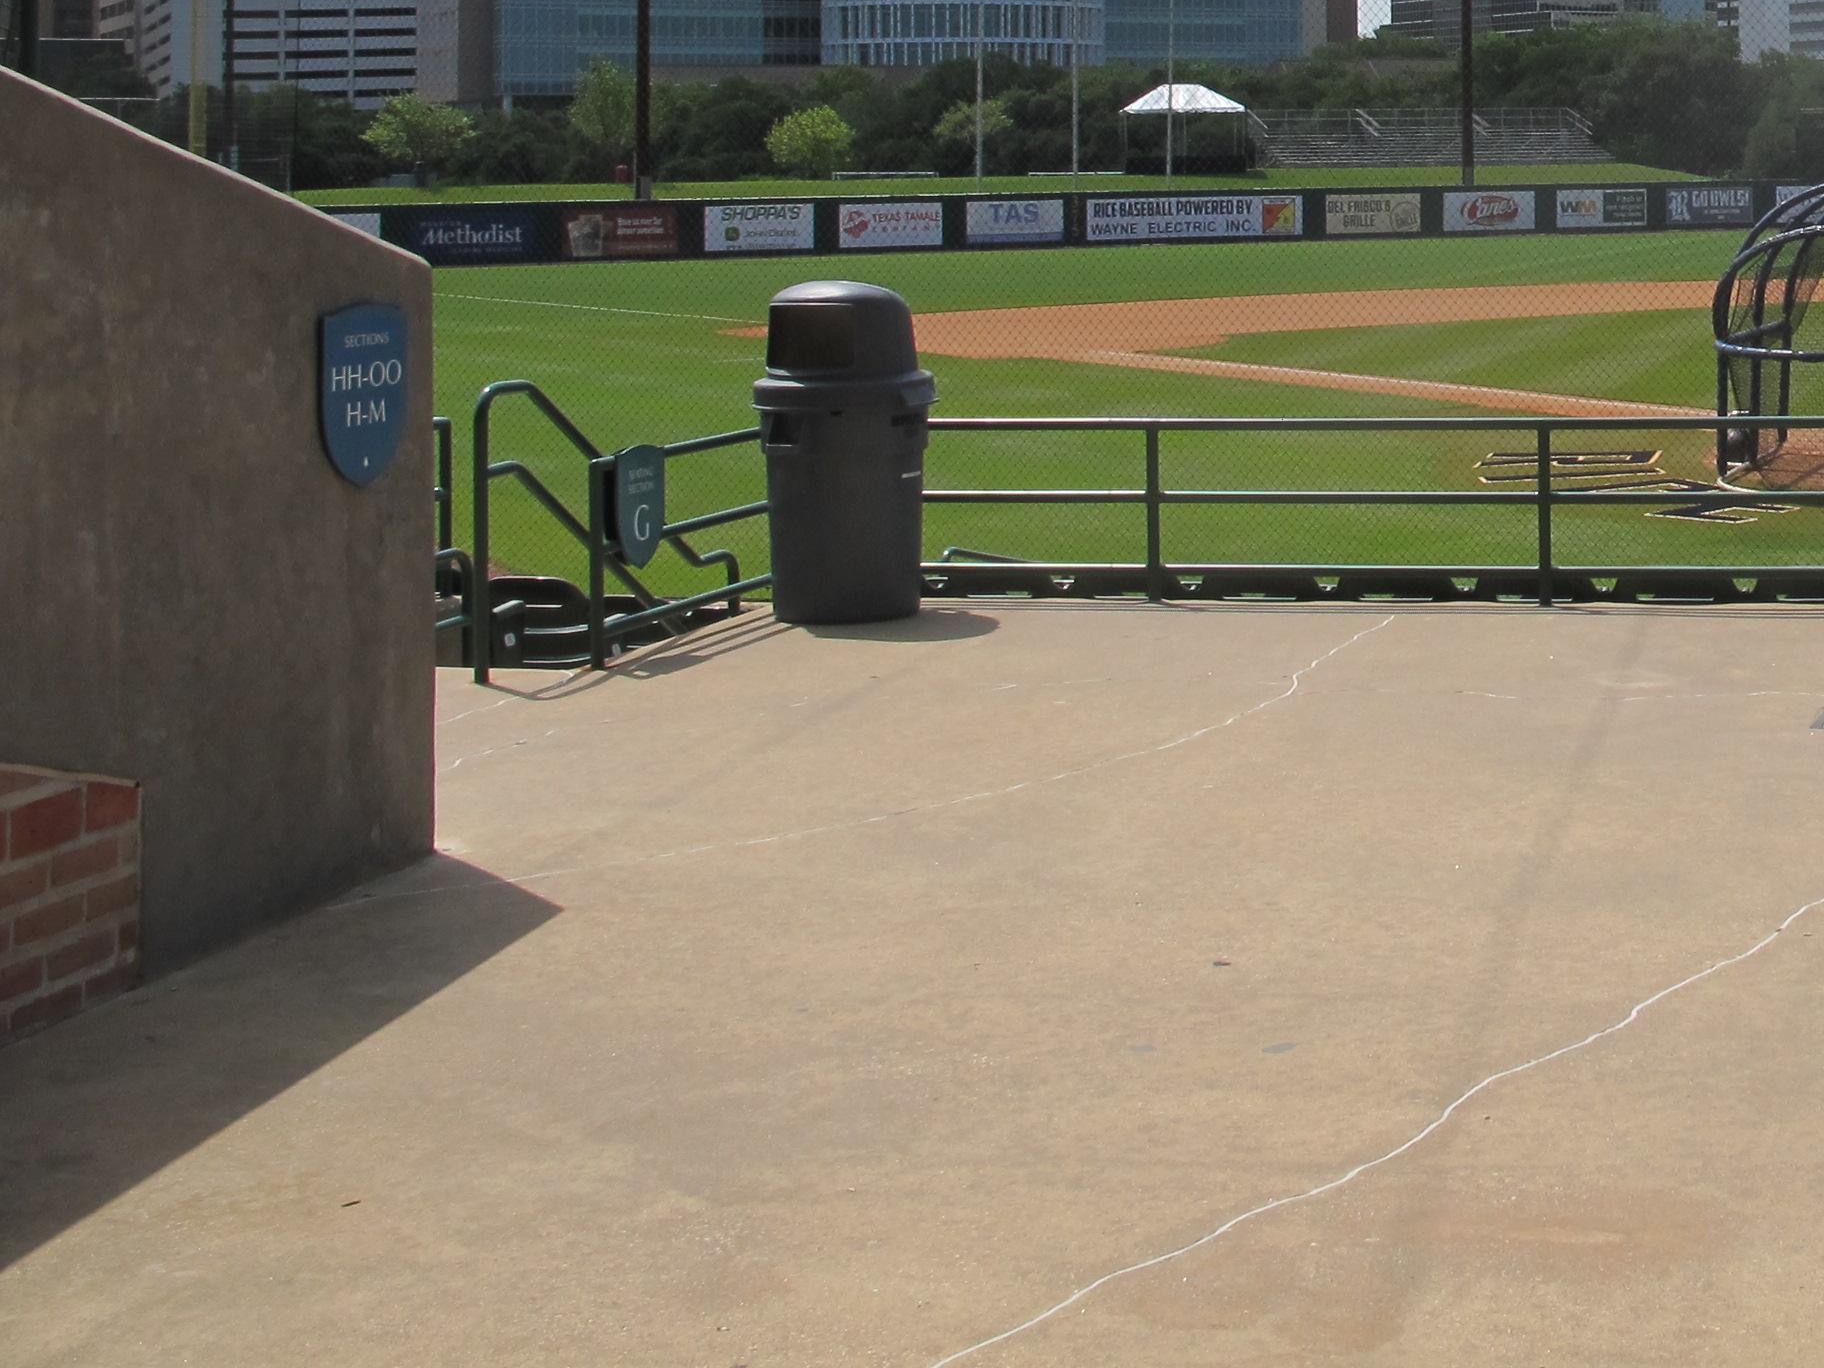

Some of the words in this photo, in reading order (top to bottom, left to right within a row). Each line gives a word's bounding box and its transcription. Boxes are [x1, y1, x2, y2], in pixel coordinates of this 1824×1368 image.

[1328, 200, 1345, 214] DEL
[1691, 190, 1708, 207] GO
[1709, 190, 1750, 207] OWLS!
[720, 206, 801, 221] SHOPPA'S
[872, 212, 902, 223] TEXAS
[904, 211, 940, 222] TAMALE
[989, 203, 1040, 225] TAS
[1093, 201, 1118, 218] RICE
[1119, 200, 1173, 217] BASEBALL
[1175, 199, 1234, 216] POWERED
[1235, 199, 1252, 215] BY
[1090, 222, 1137, 235] WAYNE
[1148, 220, 1217, 234] ELECTRIC
[1225, 219, 1257, 232] INC.
[1343, 214, 1376, 228] GRILLE
[422, 224, 523, 245] Methodist
[344, 332, 390, 348] SECTIONS
[331, 359, 402, 392] HH-OO
[346, 397, 386, 427] H-M
[633, 504, 649, 541] G
